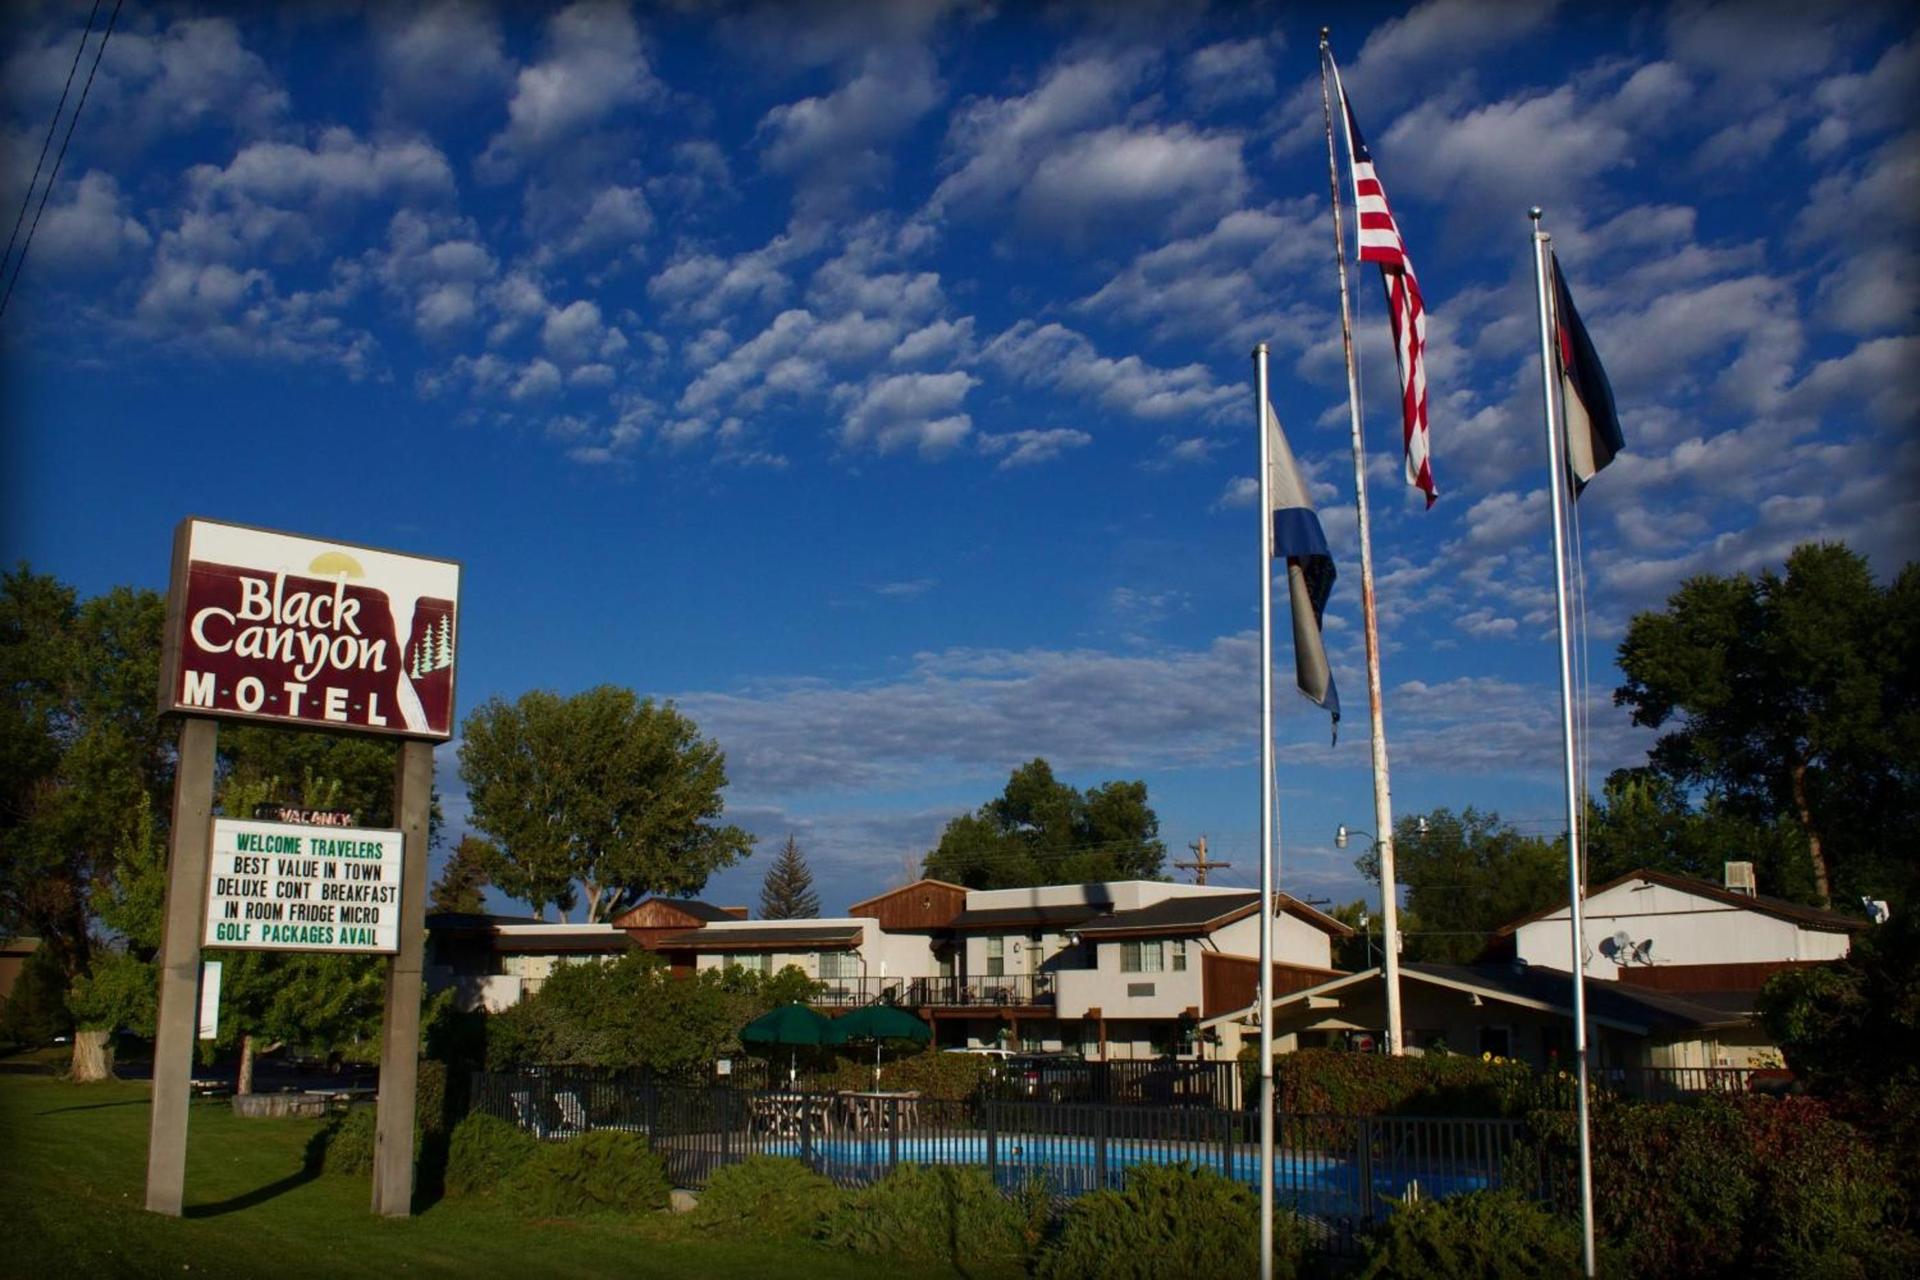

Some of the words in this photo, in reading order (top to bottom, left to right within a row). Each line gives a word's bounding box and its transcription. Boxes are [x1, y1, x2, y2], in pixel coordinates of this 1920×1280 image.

[237, 568, 361, 635] Black
[191, 607, 387, 681] Canyon
[237, 833, 301, 854] WELCOME
[310, 839, 383, 859] TRAVELERS
[234, 856, 269, 875] BEST
[277, 859, 318, 878] VALUE
[324, 861, 336, 879] IN
[345, 863, 381, 881] TOWN
[217, 878, 267, 897] DELUXE
[276, 881, 312, 899] CONT
[322, 883, 396, 903] BREAKFAST
[224, 901, 239, 918] IN
[245, 902, 283, 920] ROOM
[289, 904, 334, 923] FRIDGE
[340, 906, 380, 924] MICRO
[217, 923, 250, 941] GOLF
[262, 925, 333, 944] PACKAGES
[339, 927, 378, 945] AVAIL
